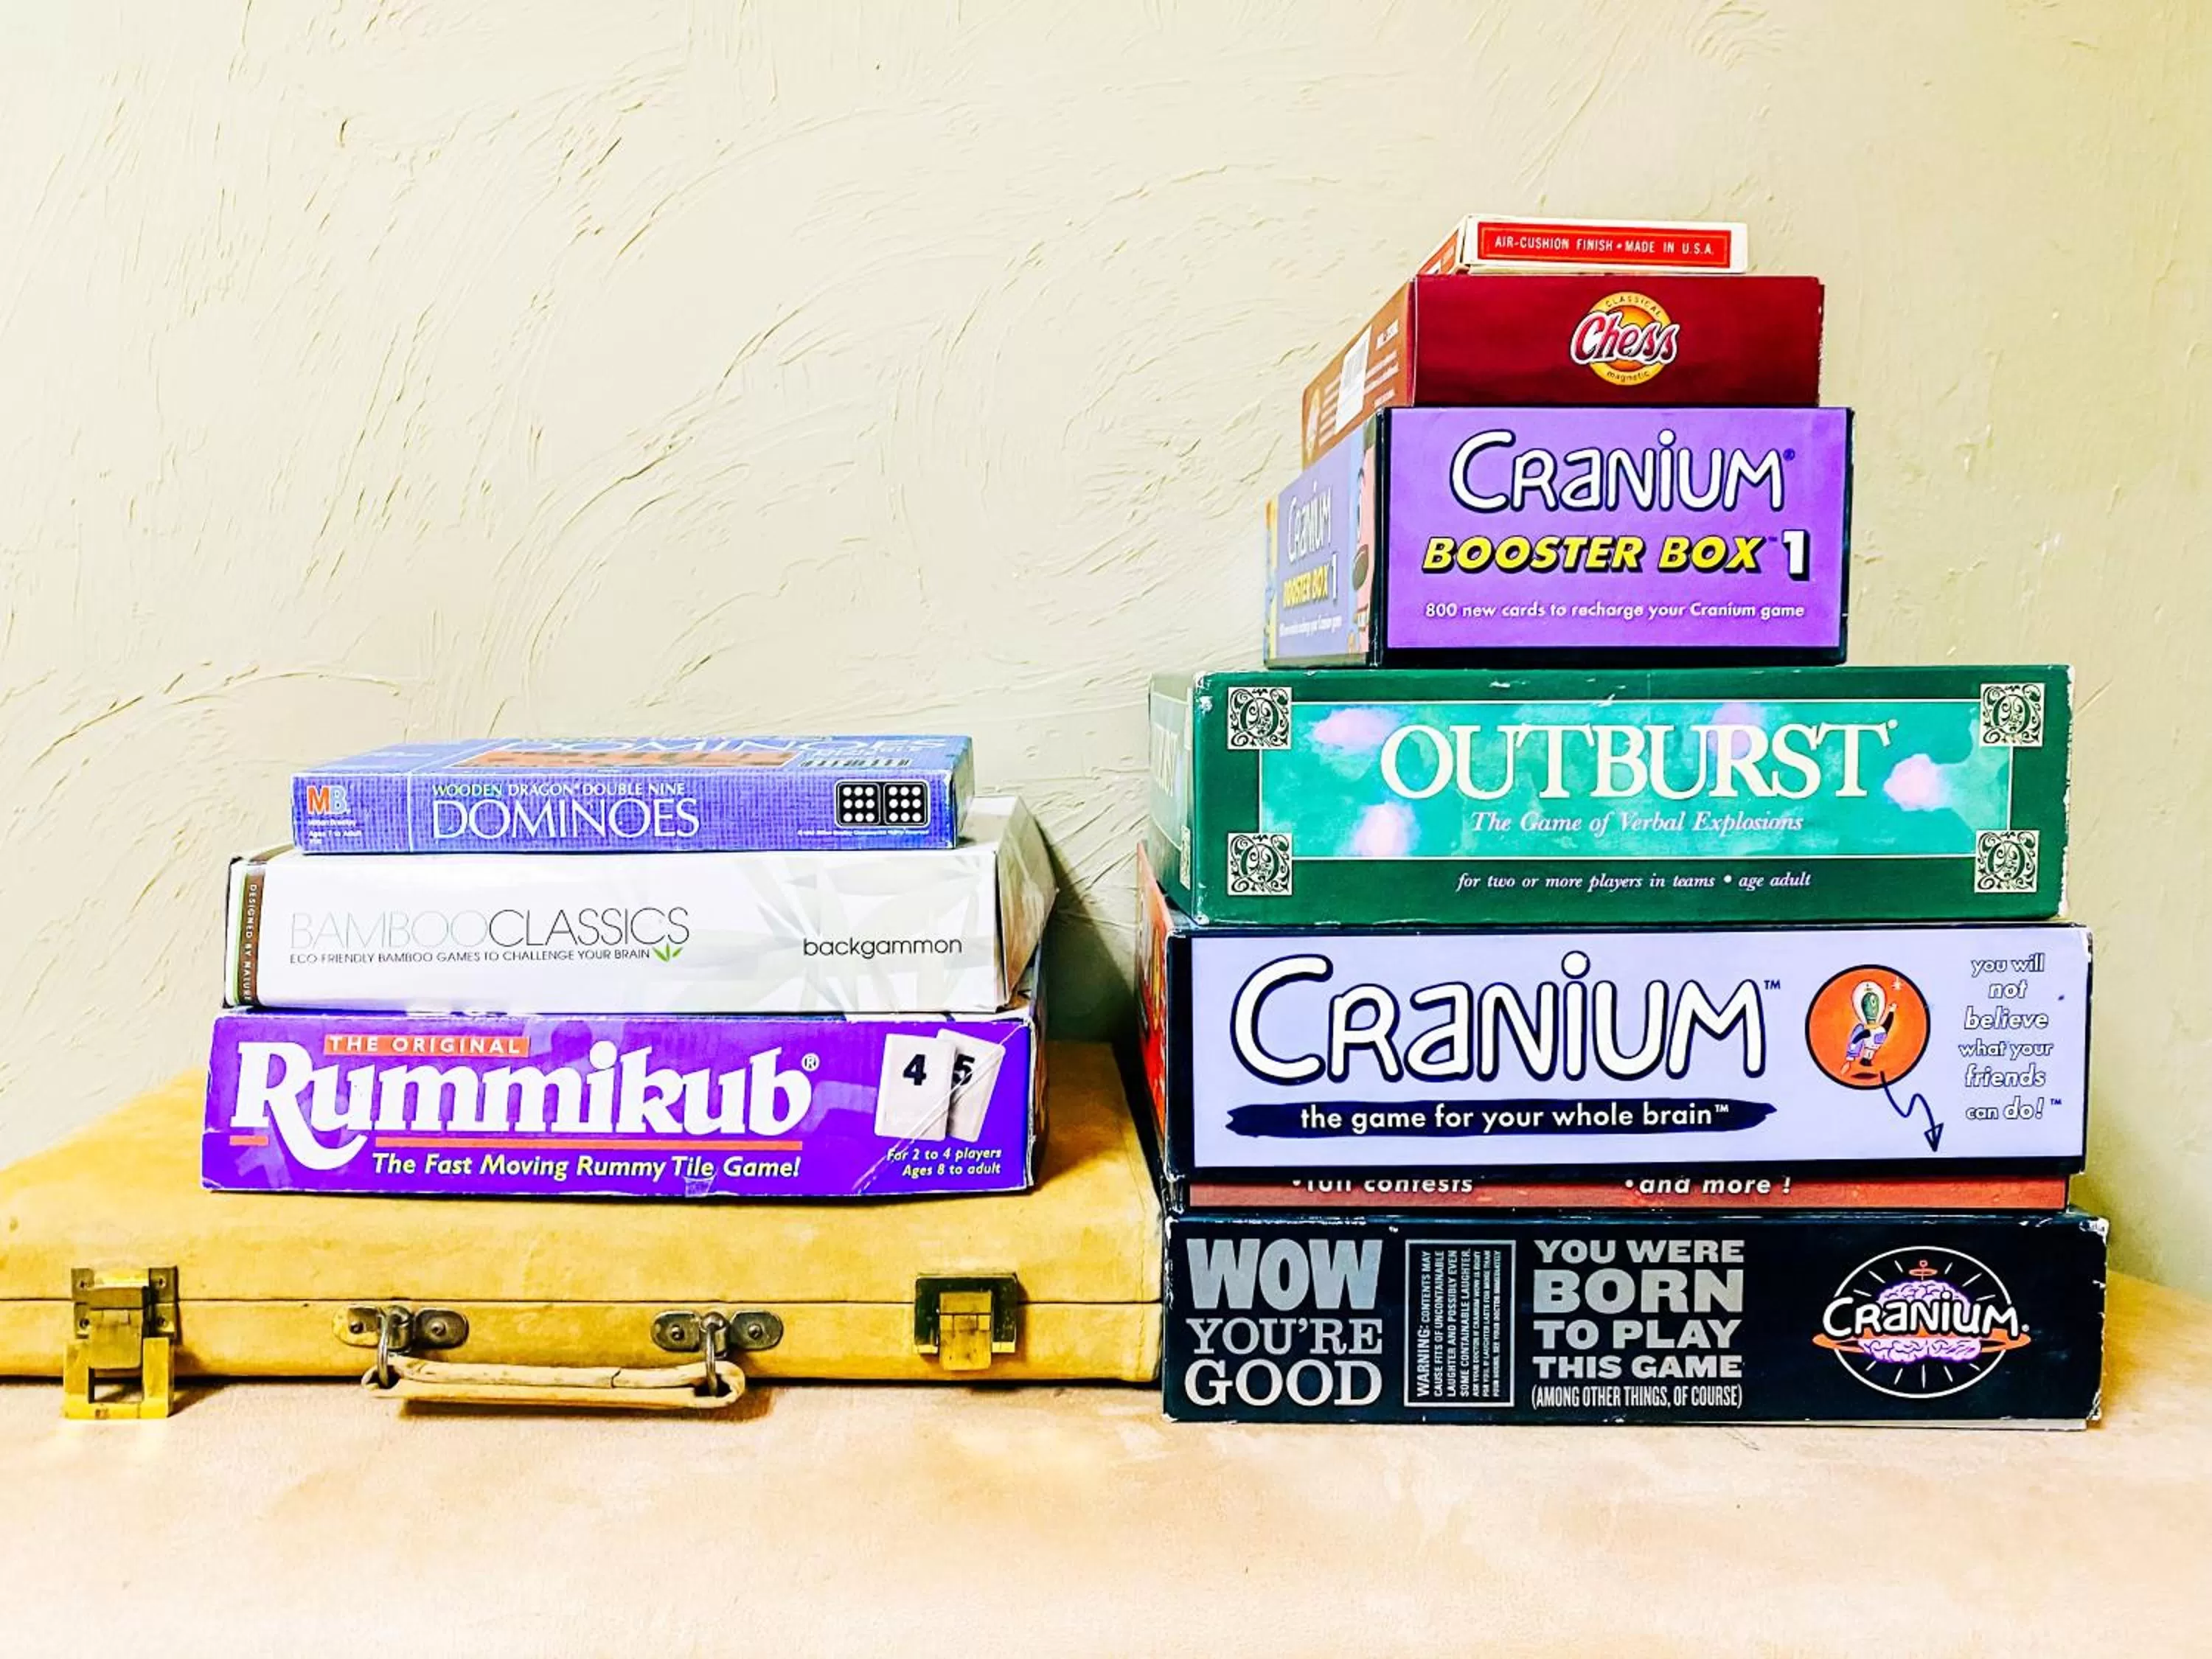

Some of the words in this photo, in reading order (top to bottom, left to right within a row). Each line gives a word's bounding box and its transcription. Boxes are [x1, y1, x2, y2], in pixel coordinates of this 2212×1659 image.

[1495, 235, 1570, 250] AIR-CUSHION
[1576, 237, 1613, 251] FINISH
[1625, 240, 1655, 253] MADE
[1663, 241, 1674, 254] IN
[1605, 295, 1662, 318] CLASSICAL
[1571, 311, 1680, 364] Chess
[1607, 370, 1650, 383] magnetic
[1422, 535, 1645, 574] BOOSTER
[1658, 535, 1767, 574] BOX
[1781, 529, 1810, 581] 1
[1425, 602, 1458, 617] 800
[1462, 605, 1496, 617] new
[1502, 601, 1545, 617] cards
[1550, 602, 1567, 617] to
[1571, 601, 1644, 620] recharge
[1649, 605, 1686, 620] your
[1690, 602, 1756, 616] Cranium
[1760, 605, 1804, 620] game
[1380, 722, 1892, 800] OUTBURST
[307, 785, 347, 815] MB
[432, 784, 502, 797] WOODEN
[508, 783, 574, 796] DRAGON
[582, 783, 643, 796] DOUBLE
[648, 782, 685, 795] NINE
[433, 797, 700, 840] DOMINOES
[1471, 811, 1511, 832] The
[1520, 811, 1582, 832] Game
[1589, 811, 1613, 838] of
[1620, 811, 1684, 832] Verbal
[1695, 810, 1804, 838] Explosions
[1456, 872, 1481, 893] for
[1486, 874, 1515, 888] two
[1522, 875, 1539, 888] or
[1545, 875, 1583, 888] more
[1588, 873, 1643, 893] players
[1649, 873, 1666, 888] in
[1672, 874, 1715, 888] teams
[1738, 875, 1764, 892] age
[1770, 873, 1812, 888] adult
[246, 884, 258, 939] DESIGNED
[244, 943, 253, 956] BY
[378, 952, 433, 963] BAMBOO
[436, 952, 480, 962] GAMES
[484, 950, 499, 961] TO
[503, 950, 574, 961] CHALLENGE
[577, 949, 611, 959] YOUR
[614, 948, 650, 959] BRAIN
[803, 937, 962, 959] backgammon
[1970, 959, 2008, 978] you
[2011, 952, 2045, 972] will
[1988, 979, 2028, 998] not
[1964, 1006, 2049, 1029] believe
[330, 1036, 378, 1052] THE
[392, 1036, 521, 1054] ORIGINAL
[1958, 1038, 2006, 1057] what
[2010, 1043, 2053, 1060] your
[902, 1054, 928, 1086] 4
[1965, 1062, 2046, 1087] friends
[1301, 1105, 1342, 1128] the
[1352, 1110, 1426, 1134] game
[1435, 1104, 1474, 1127] for
[1482, 1108, 1544, 1133] your
[1552, 1102, 1634, 1127] whole
[1966, 1107, 1999, 1120] can
[2003, 1096, 2045, 1120] do!
[886, 1147, 909, 1161] For
[912, 1148, 920, 1161] 2
[925, 1150, 939, 1160] to
[942, 1147, 952, 1160] 4
[955, 1147, 1002, 1162] players
[372, 1152, 416, 1174] The
[425, 1153, 473, 1175] Fast
[480, 1154, 569, 1181] Moving
[577, 1155, 667, 1183] Rummy
[671, 1155, 714, 1177] Tile
[723, 1156, 801, 1178] Game!
[902, 1164, 933, 1180] Ages
[937, 1163, 945, 1175] 8
[949, 1164, 963, 1175] to
[967, 1161, 1001, 1175] adult
[1639, 1178, 1691, 1194] and
[1702, 1179, 1771, 1194] more
[1422, 1251, 1430, 1272] MAY
[1448, 1251, 1458, 1274] EVEN
[1534, 1239, 1616, 1264] YOU
[1626, 1239, 1745, 1263] WERE
[1186, 1238, 1383, 1311] WOW
[1422, 1275, 1430, 1323] CONTENTS
[1434, 1251, 1444, 1329] UNCONTAINABLE
[1448, 1277, 1457, 1322] POSSIBLY
[1533, 1267, 1744, 1314] BORN
[1186, 1317, 1382, 1355] YOU'RE
[1434, 1331, 1443, 1342] OF
[1448, 1325, 1456, 1345] AND
[1461, 1301, 1470, 1366] CONTAINABLE
[1533, 1319, 1599, 1349] TO
[1613, 1318, 1742, 1349] PLAY
[1417, 1325, 1430, 1397] WARNING:
[1434, 1345, 1443, 1363] FITS
[1532, 1354, 1622, 1379] THIS
[1631, 1354, 1743, 1379] GAME
[1184, 1358, 1382, 1407] GOOD
[1434, 1366, 1443, 1397] CAUSE
[1447, 1348, 1456, 1397] LAUGHTER
[1461, 1370, 1470, 1397] SOME
[1531, 1384, 1579, 1410] (AMONG
[1582, 1385, 1621, 1408] OTHER
[1624, 1385, 1671, 1408] THINGS,
[1673, 1385, 1688, 1407] OF
[1691, 1383, 1743, 1409] COURSE)
